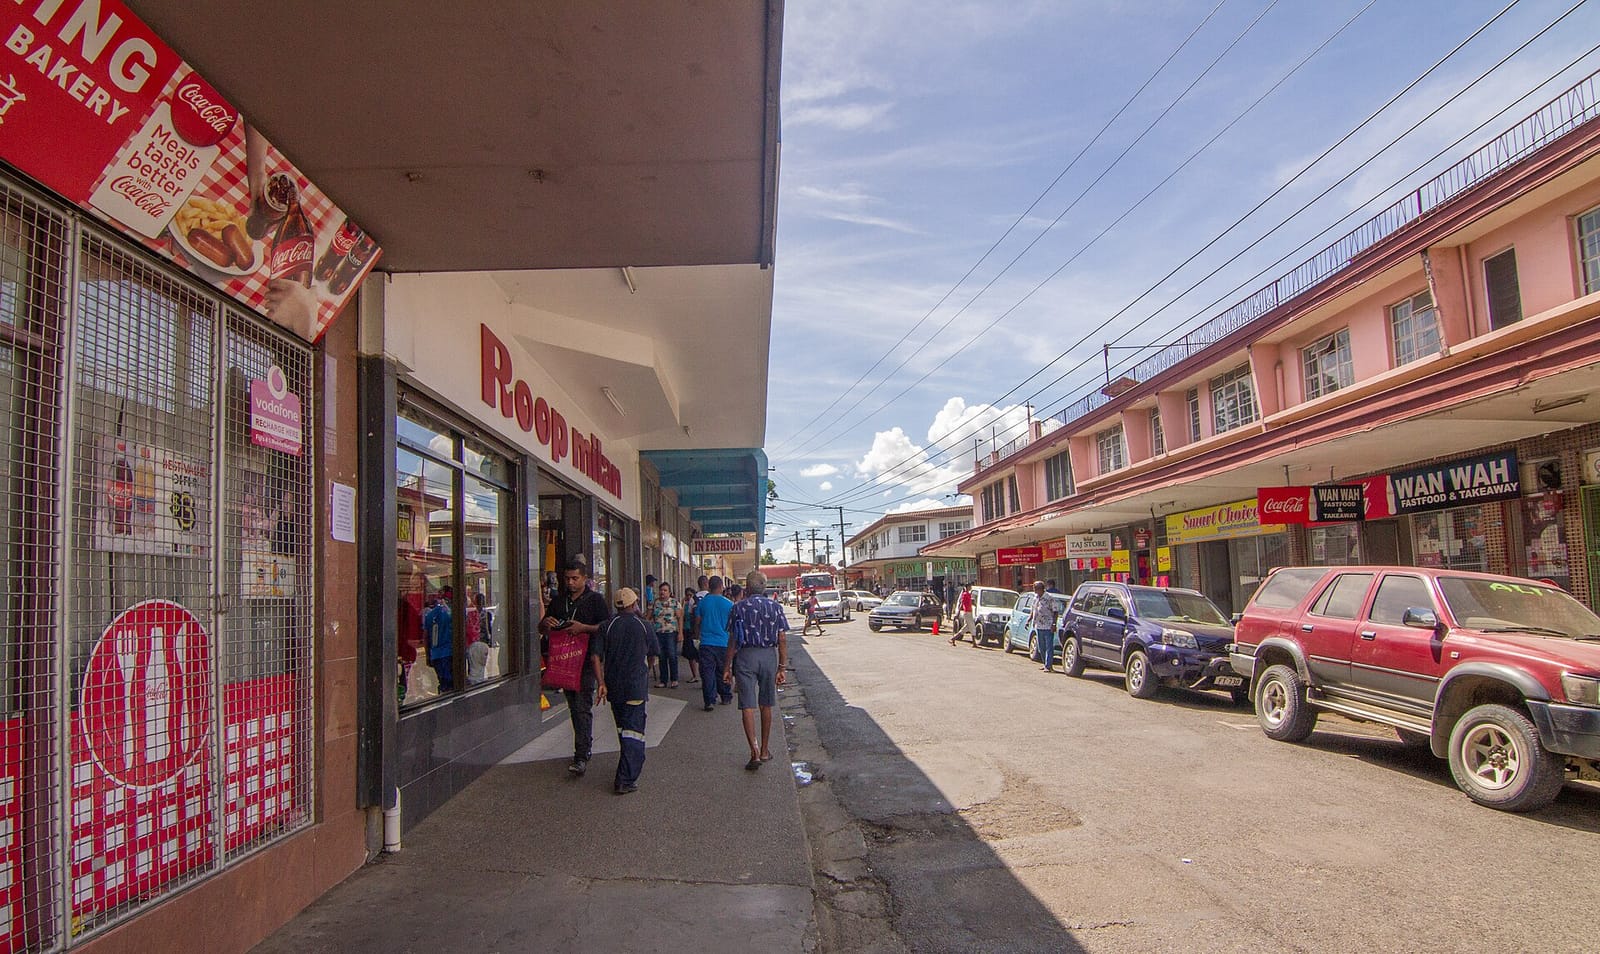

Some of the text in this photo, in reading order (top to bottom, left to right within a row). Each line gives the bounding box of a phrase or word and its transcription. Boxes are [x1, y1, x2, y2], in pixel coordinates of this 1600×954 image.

[15, 0, 157, 93] ING
[5, 24, 130, 125] BAKERY
[178, 84, 235, 134] Coca-Cola
[144, 141, 187, 180] taste
[151, 124, 200, 169] Meals
[127, 150, 183, 197] better
[136, 177, 152, 191] with
[110, 175, 173, 218] Coca-Cola
[272, 241, 313, 273] Coca-Cola
[480, 323, 569, 463] Roop
[255, 397, 299, 422] vodafone
[256, 418, 285, 434] RECHARGE
[571, 427, 622, 500] milan
[1395, 471, 1445, 499] WAN
[1449, 458, 1510, 490] WAH
[1264, 497, 1304, 513] Coca-Cola
[1318, 488, 1337, 502] WAN
[1340, 488, 1360, 501] WAH
[1401, 482, 1519, 508] FASTFOOD & TAKEAWAY
[1183, 510, 1217, 531] Smart
[1218, 504, 1259, 525] Choice
[695, 539, 742, 552] IN FASHION
[1070, 541, 1083, 549] TAJ
[1083, 540, 1107, 548] STORE
[920, 560, 949, 572] TRDING
